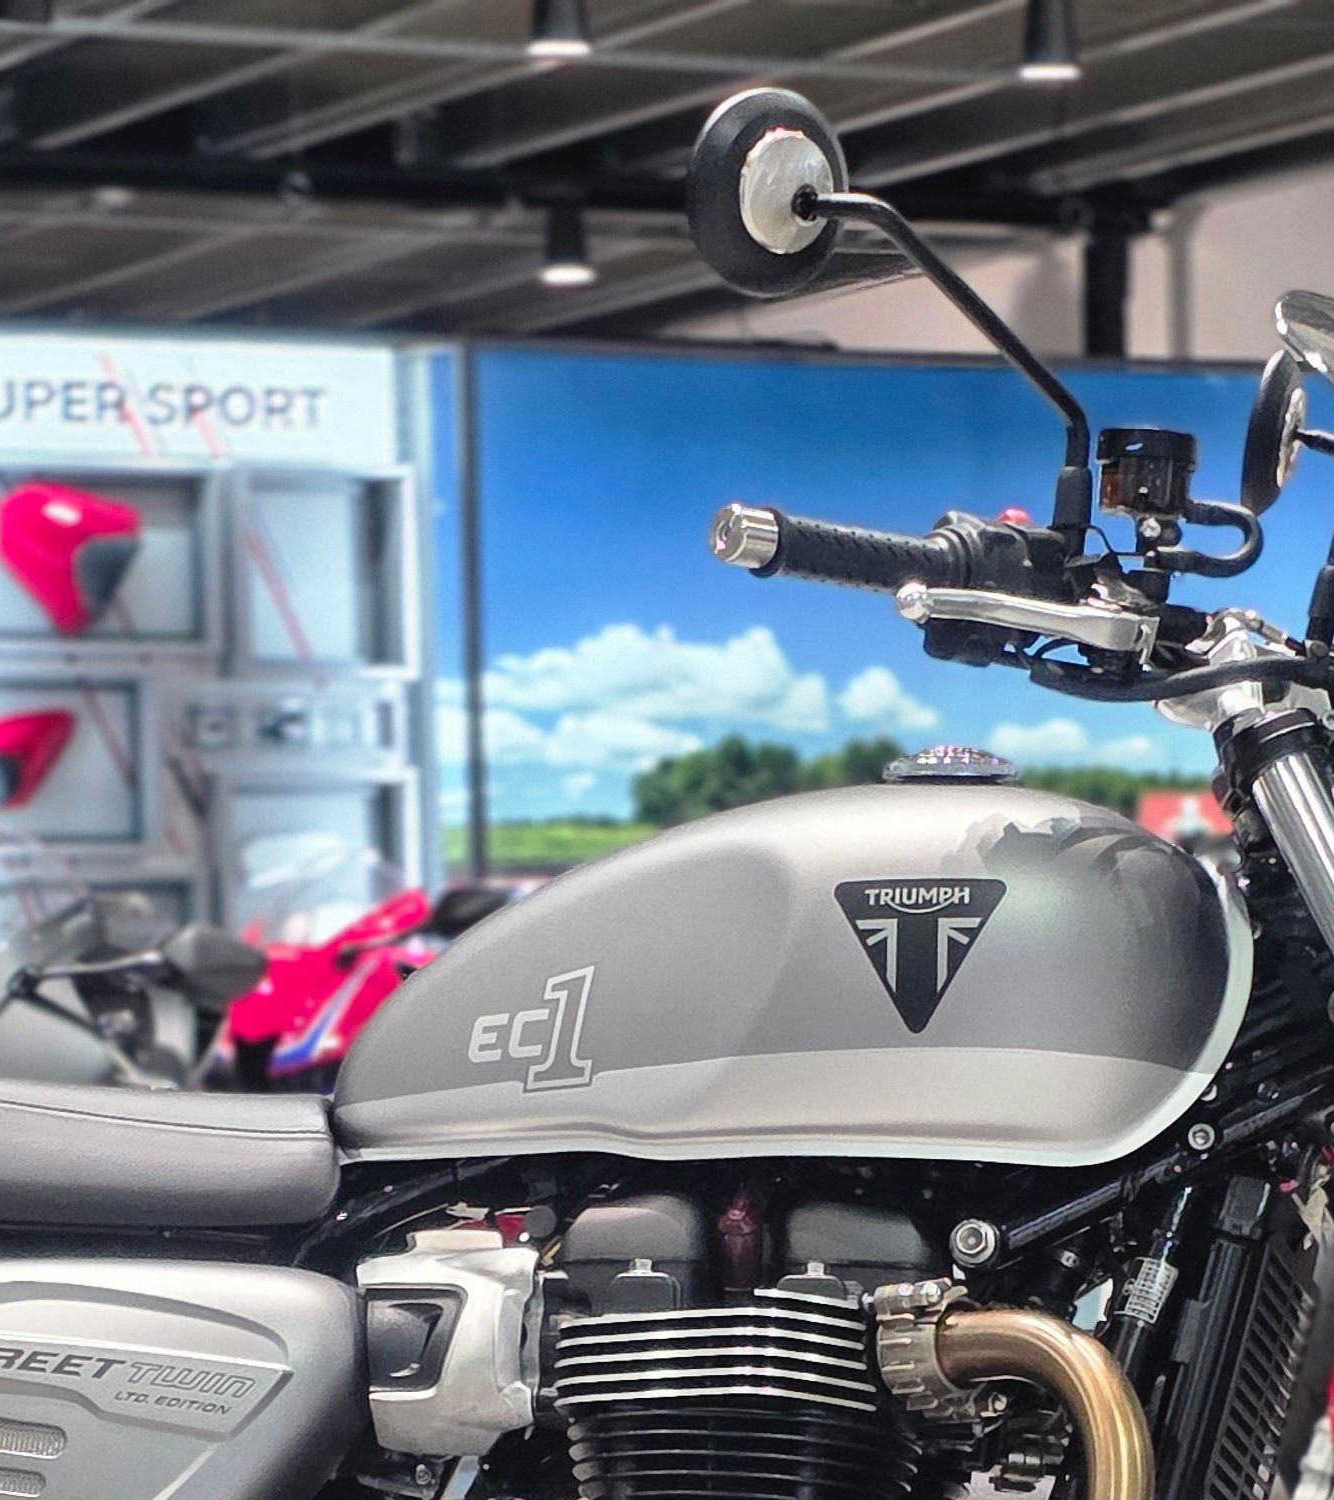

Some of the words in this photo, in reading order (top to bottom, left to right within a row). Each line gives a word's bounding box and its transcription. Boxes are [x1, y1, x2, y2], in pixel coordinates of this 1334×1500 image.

[147, 383, 325, 429] SPORT
[864, 887, 970, 912] TRIUMPH
[468, 965, 595, 1090] EC1
[129, 1361, 257, 1399] TWIN
[114, 1391, 150, 1405] LTD.
[153, 1394, 233, 1416] EDITION
